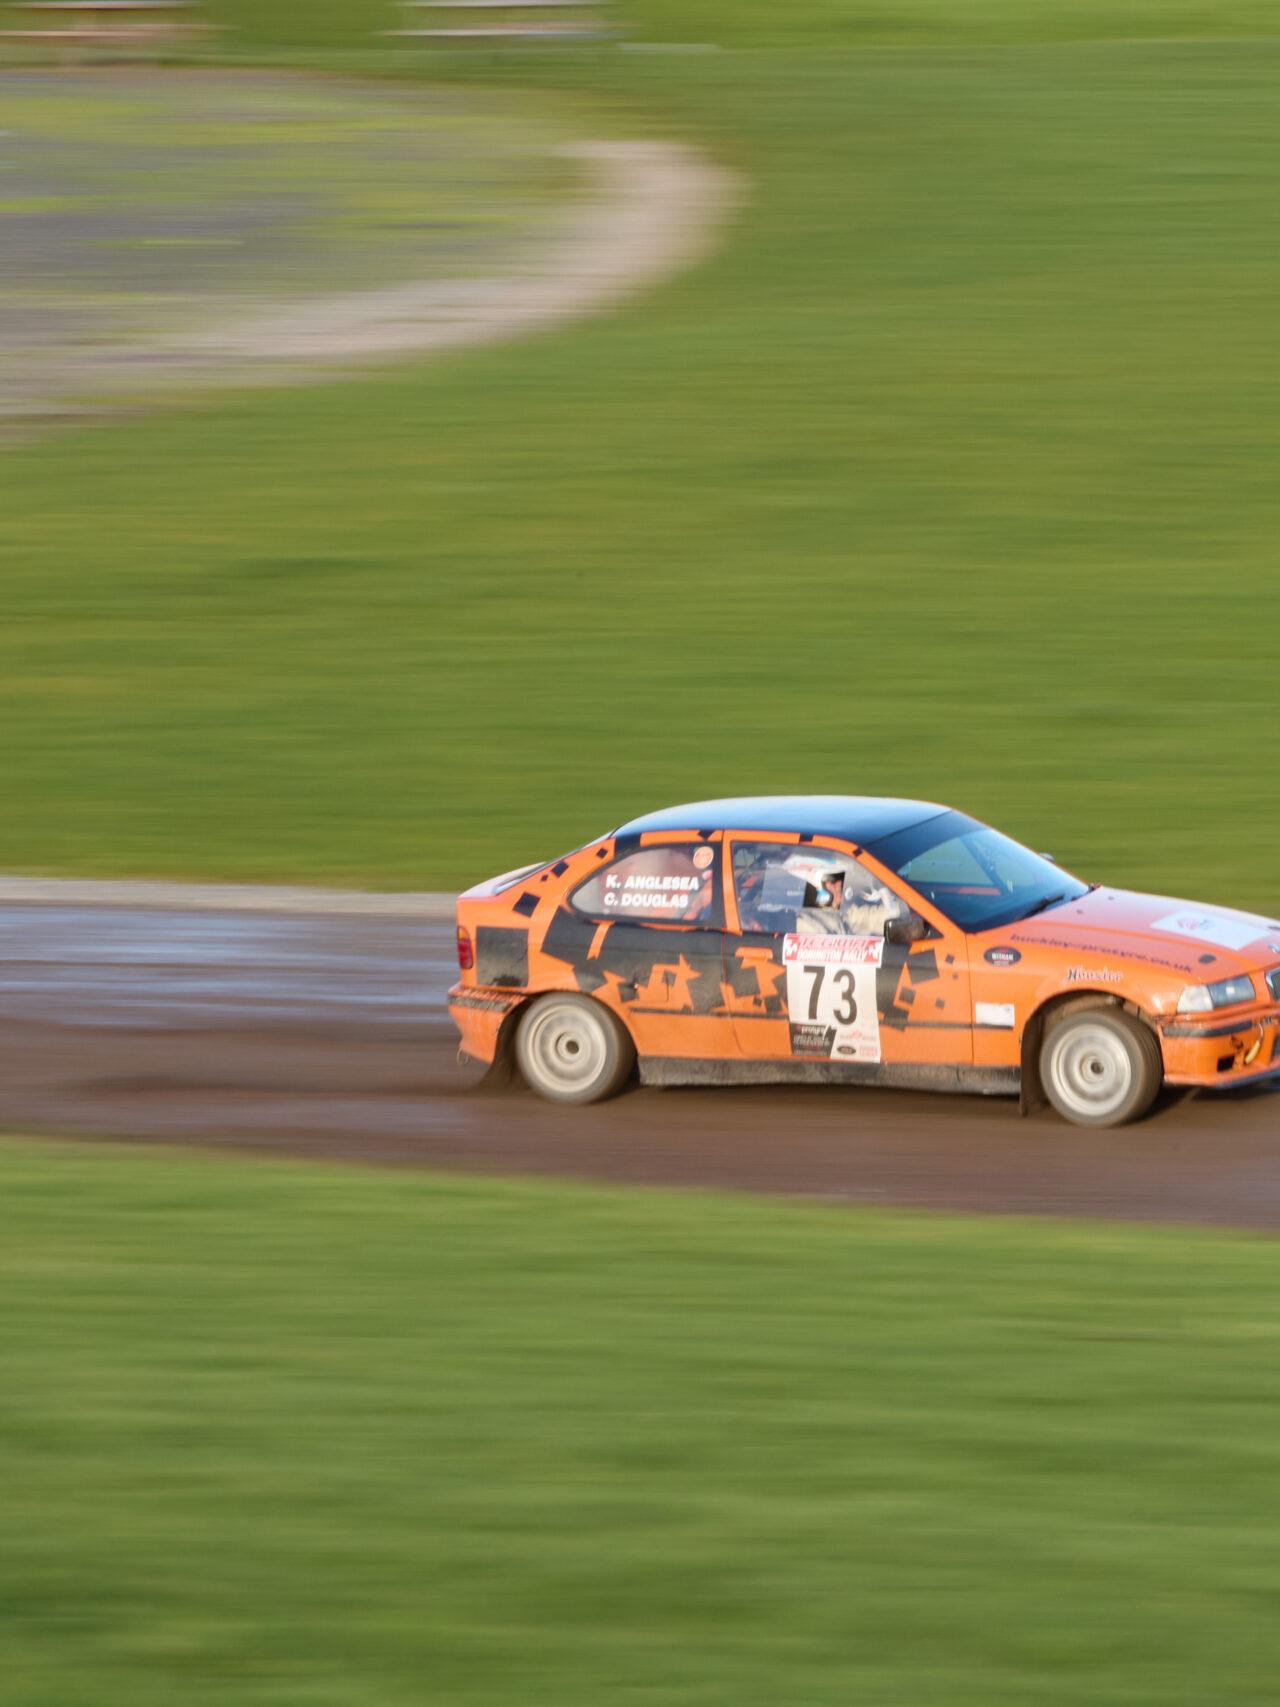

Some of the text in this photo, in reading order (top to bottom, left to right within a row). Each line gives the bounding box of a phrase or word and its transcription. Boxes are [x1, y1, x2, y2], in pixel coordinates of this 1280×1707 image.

[605, 874, 699, 891] K. ANGLESEA
[604, 892, 689, 908] C. DOUGLAS
[803, 965, 858, 1025] 73
